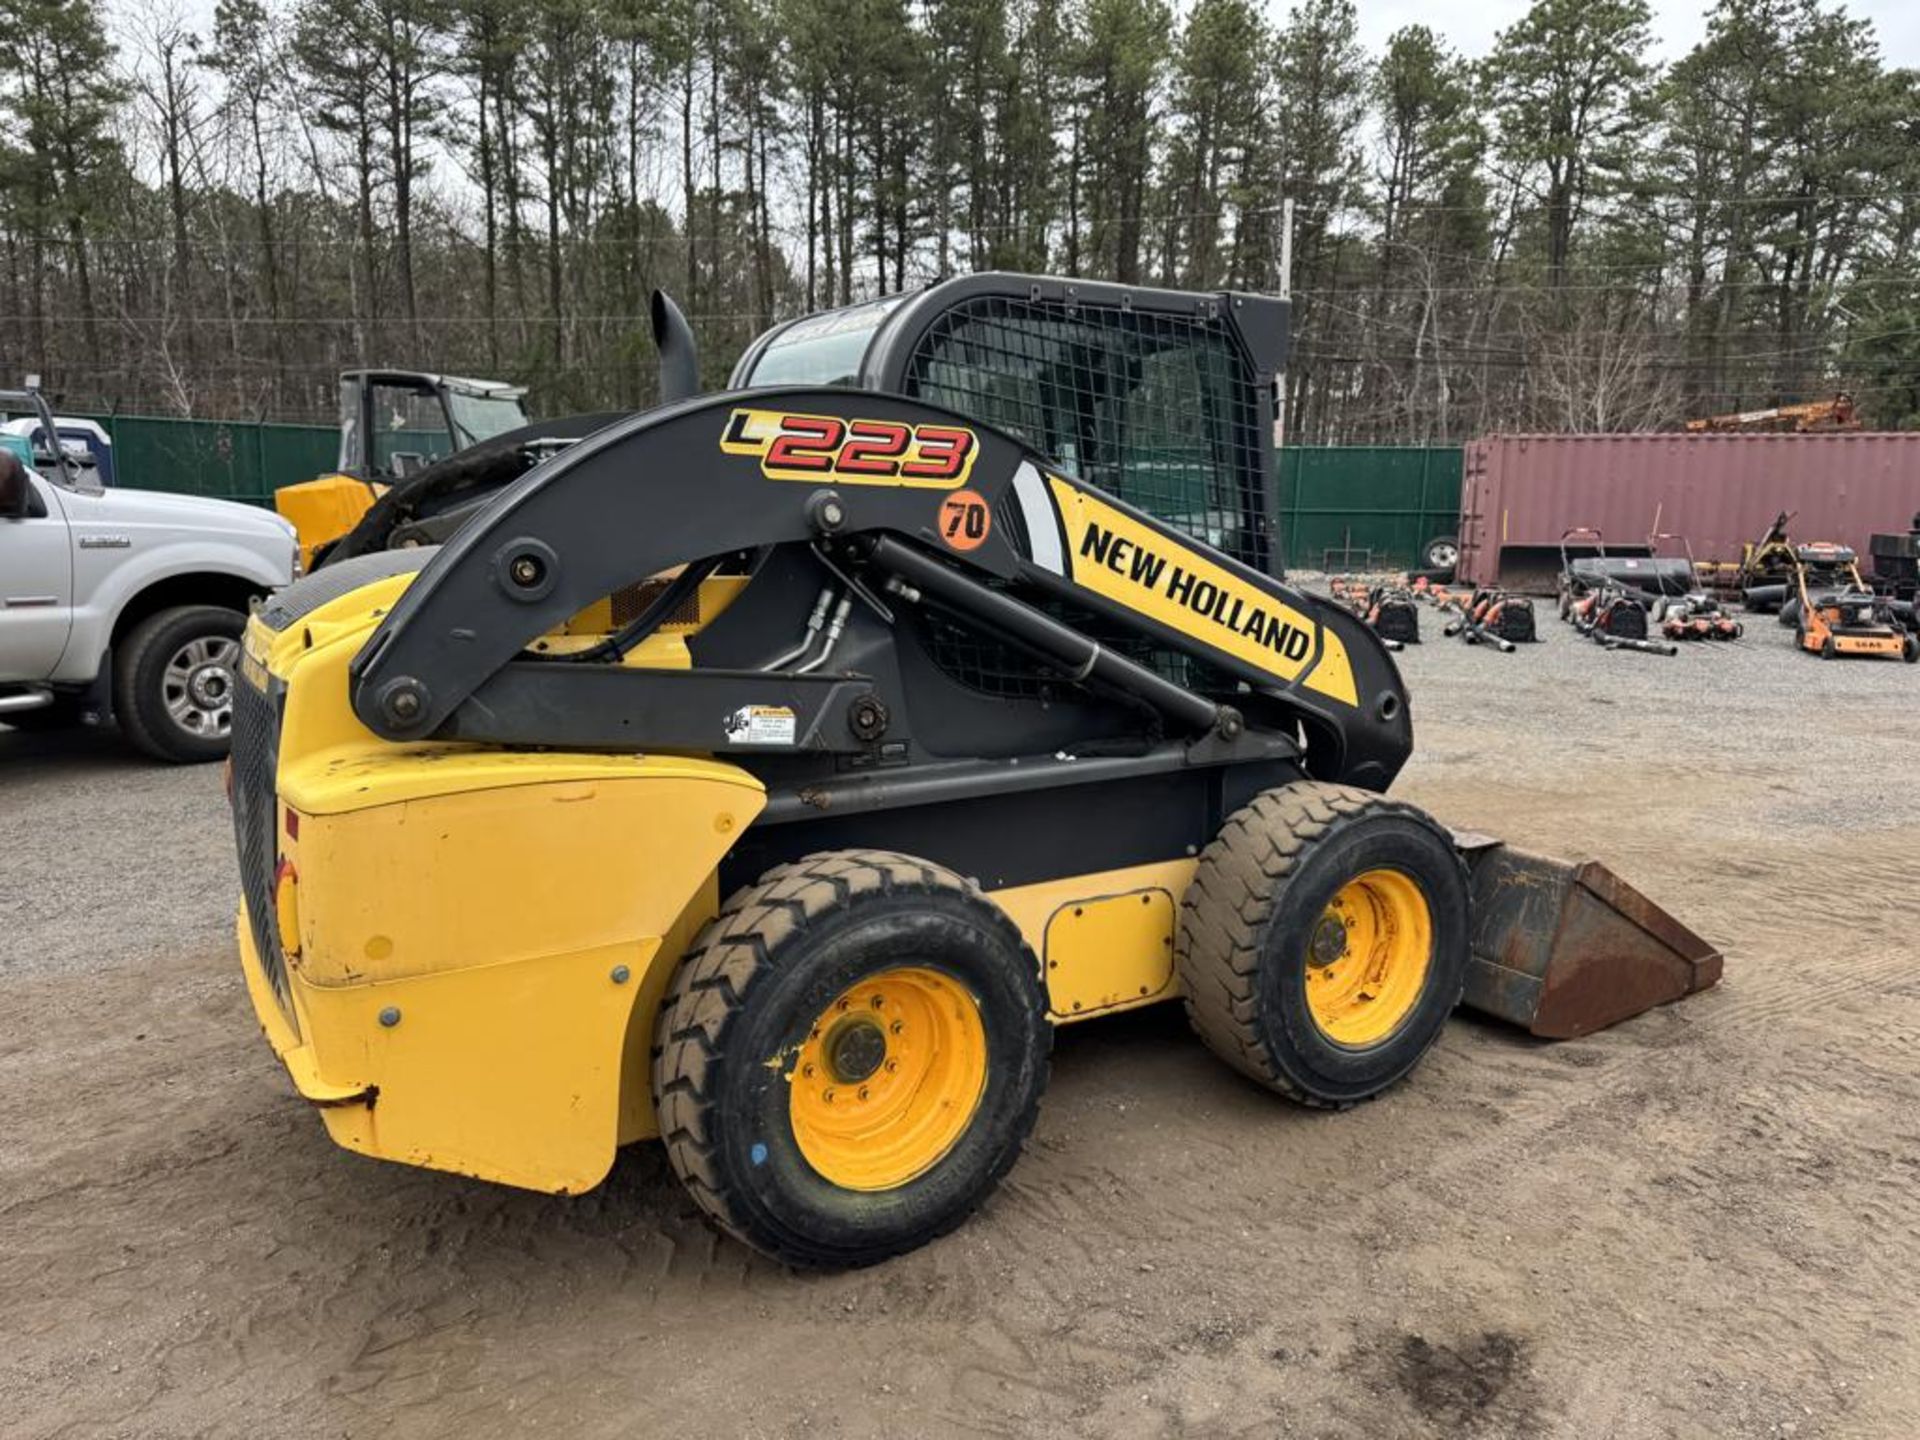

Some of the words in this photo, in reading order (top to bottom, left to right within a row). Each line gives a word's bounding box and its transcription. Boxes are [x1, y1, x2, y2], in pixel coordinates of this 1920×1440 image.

[724, 413, 975, 479] L223
[946, 502, 985, 539] 70
[1079, 522, 1167, 590] NEW
[1165, 566, 1310, 662] HOLLAND
